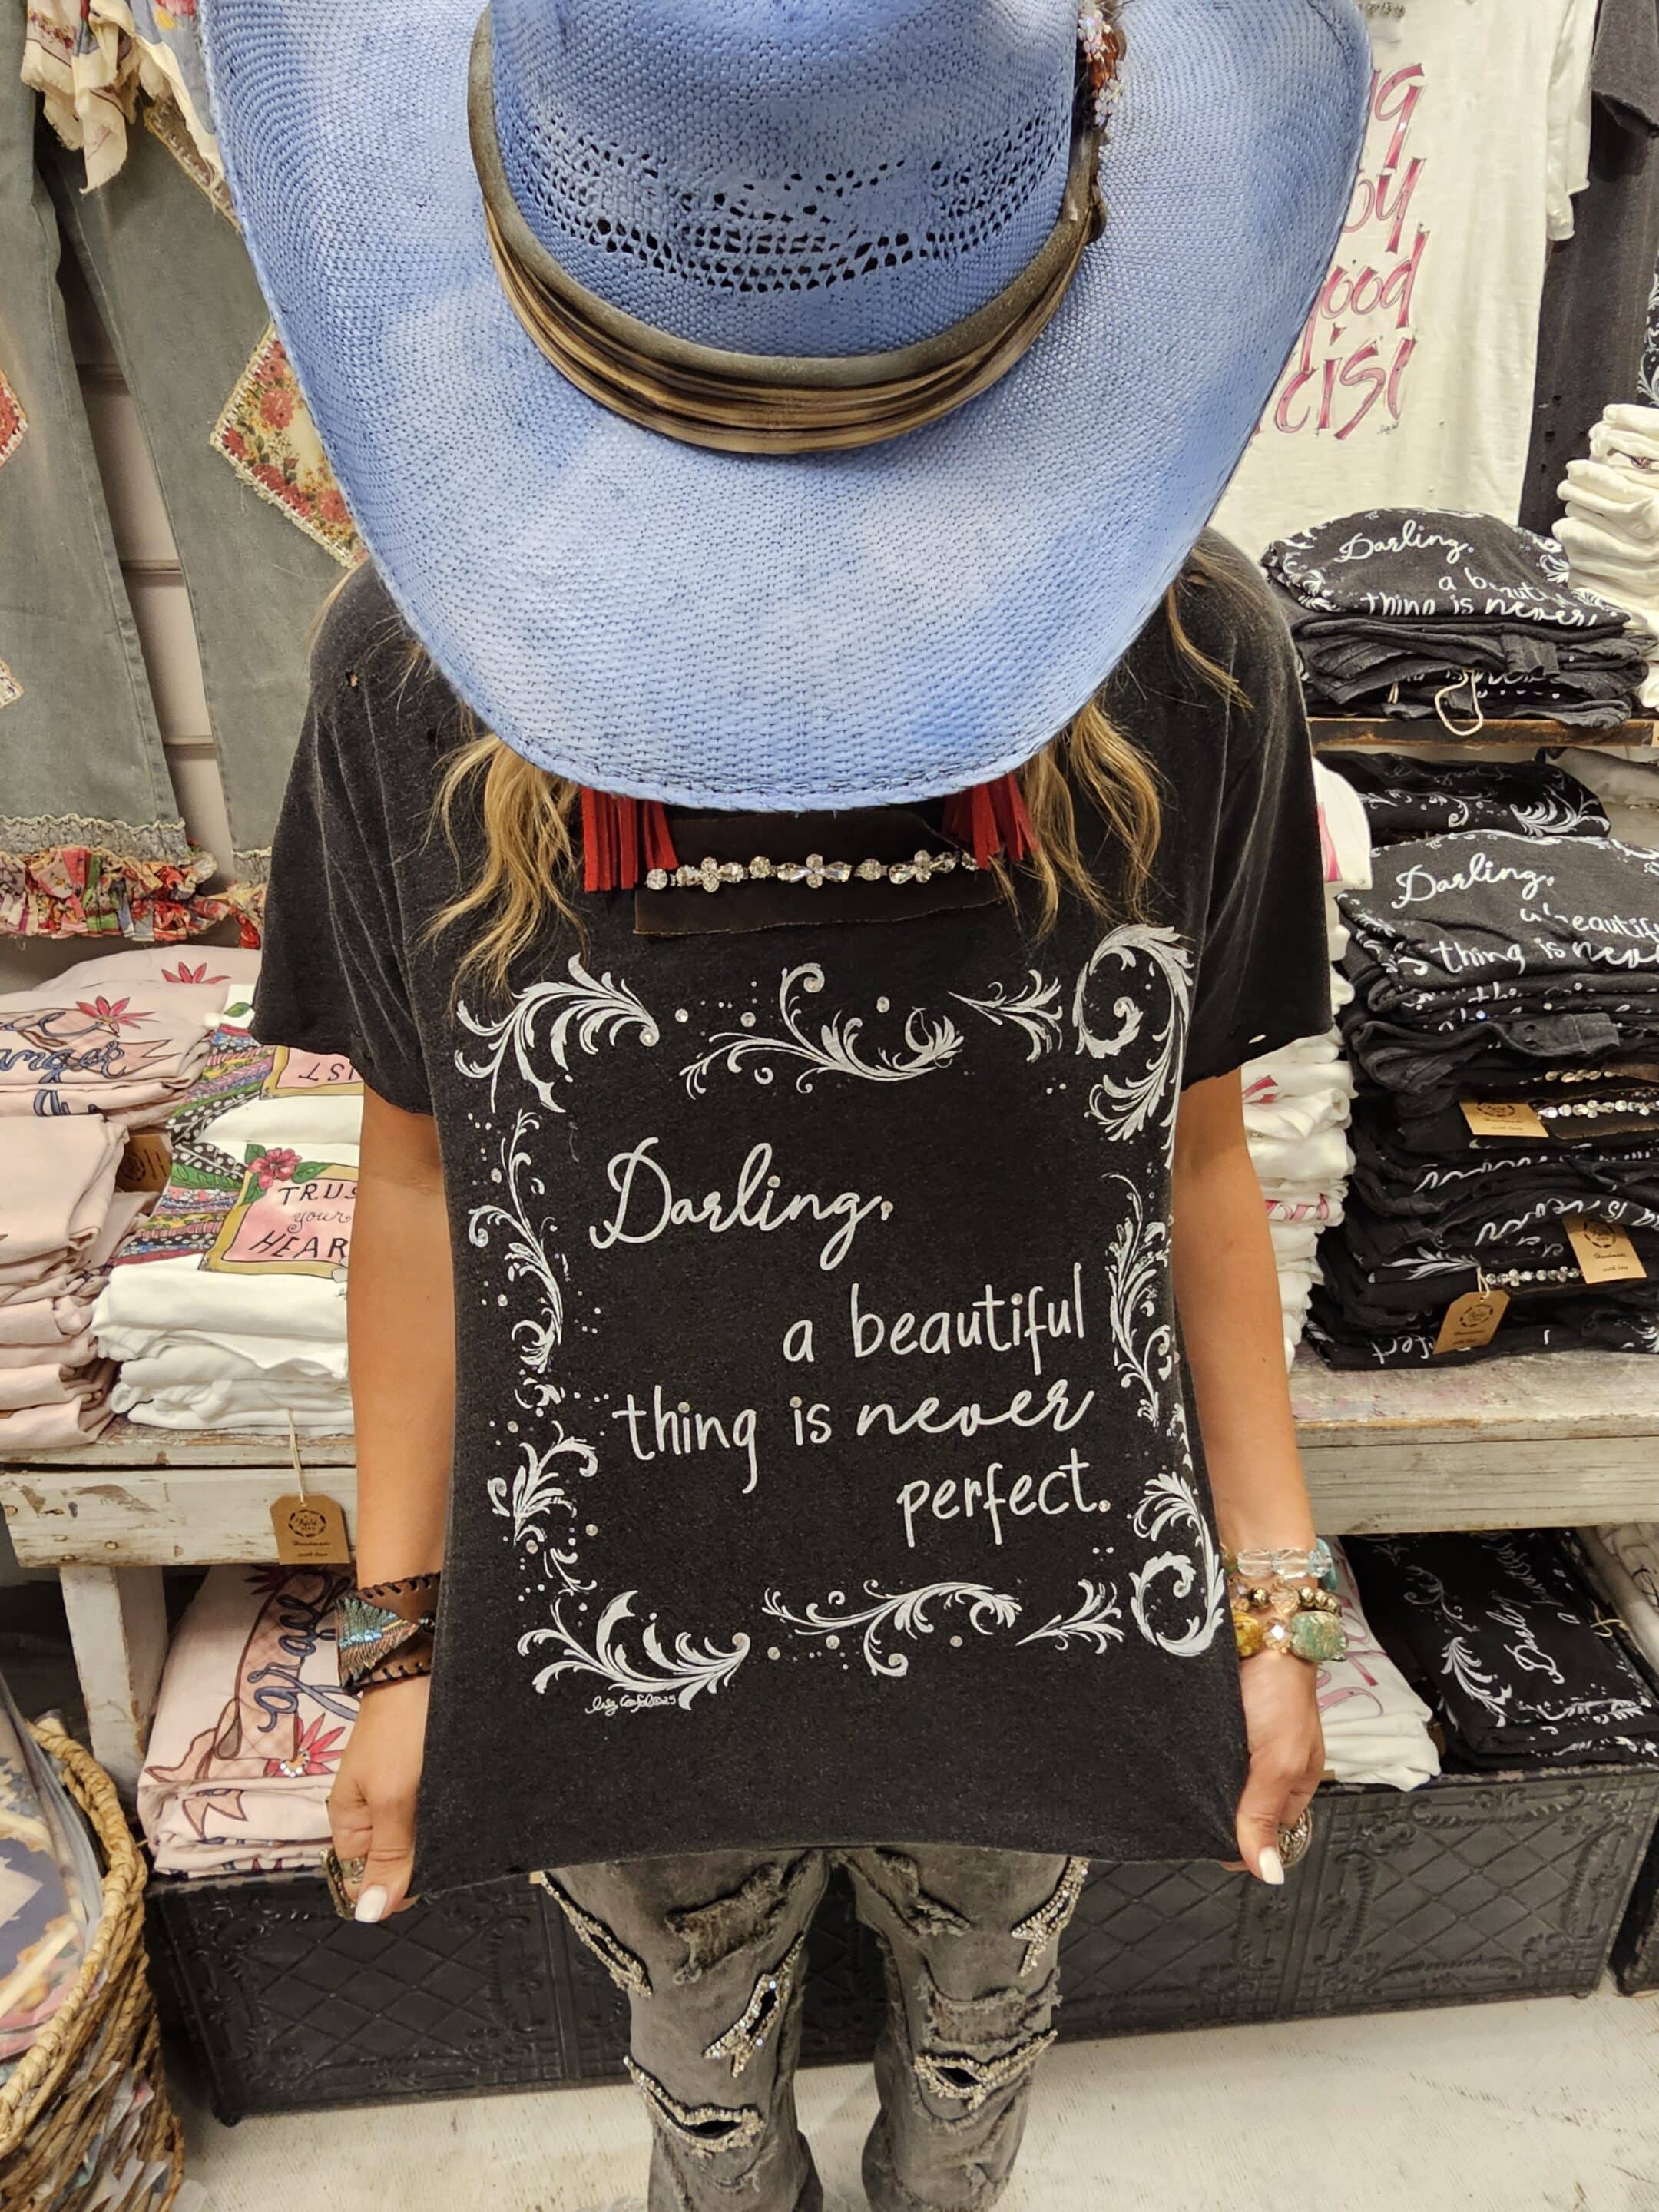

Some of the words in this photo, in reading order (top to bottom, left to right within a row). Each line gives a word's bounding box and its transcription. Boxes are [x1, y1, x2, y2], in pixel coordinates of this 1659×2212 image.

[1438, 576, 1457, 591] a
[1449, 594, 1475, 614] is
[1429, 940, 1526, 975] thing
[1534, 937, 1566, 959] is
[287, 1208, 351, 1233] your
[248, 1230, 349, 1260] HEAR
[783, 1319, 815, 1363] a
[850, 1262, 1084, 1376] beautiful
[612, 1385, 757, 1494] thing
[789, 1396, 832, 1445] is
[857, 1379, 1095, 1438] never
[896, 1448, 1111, 1548] perfect.
